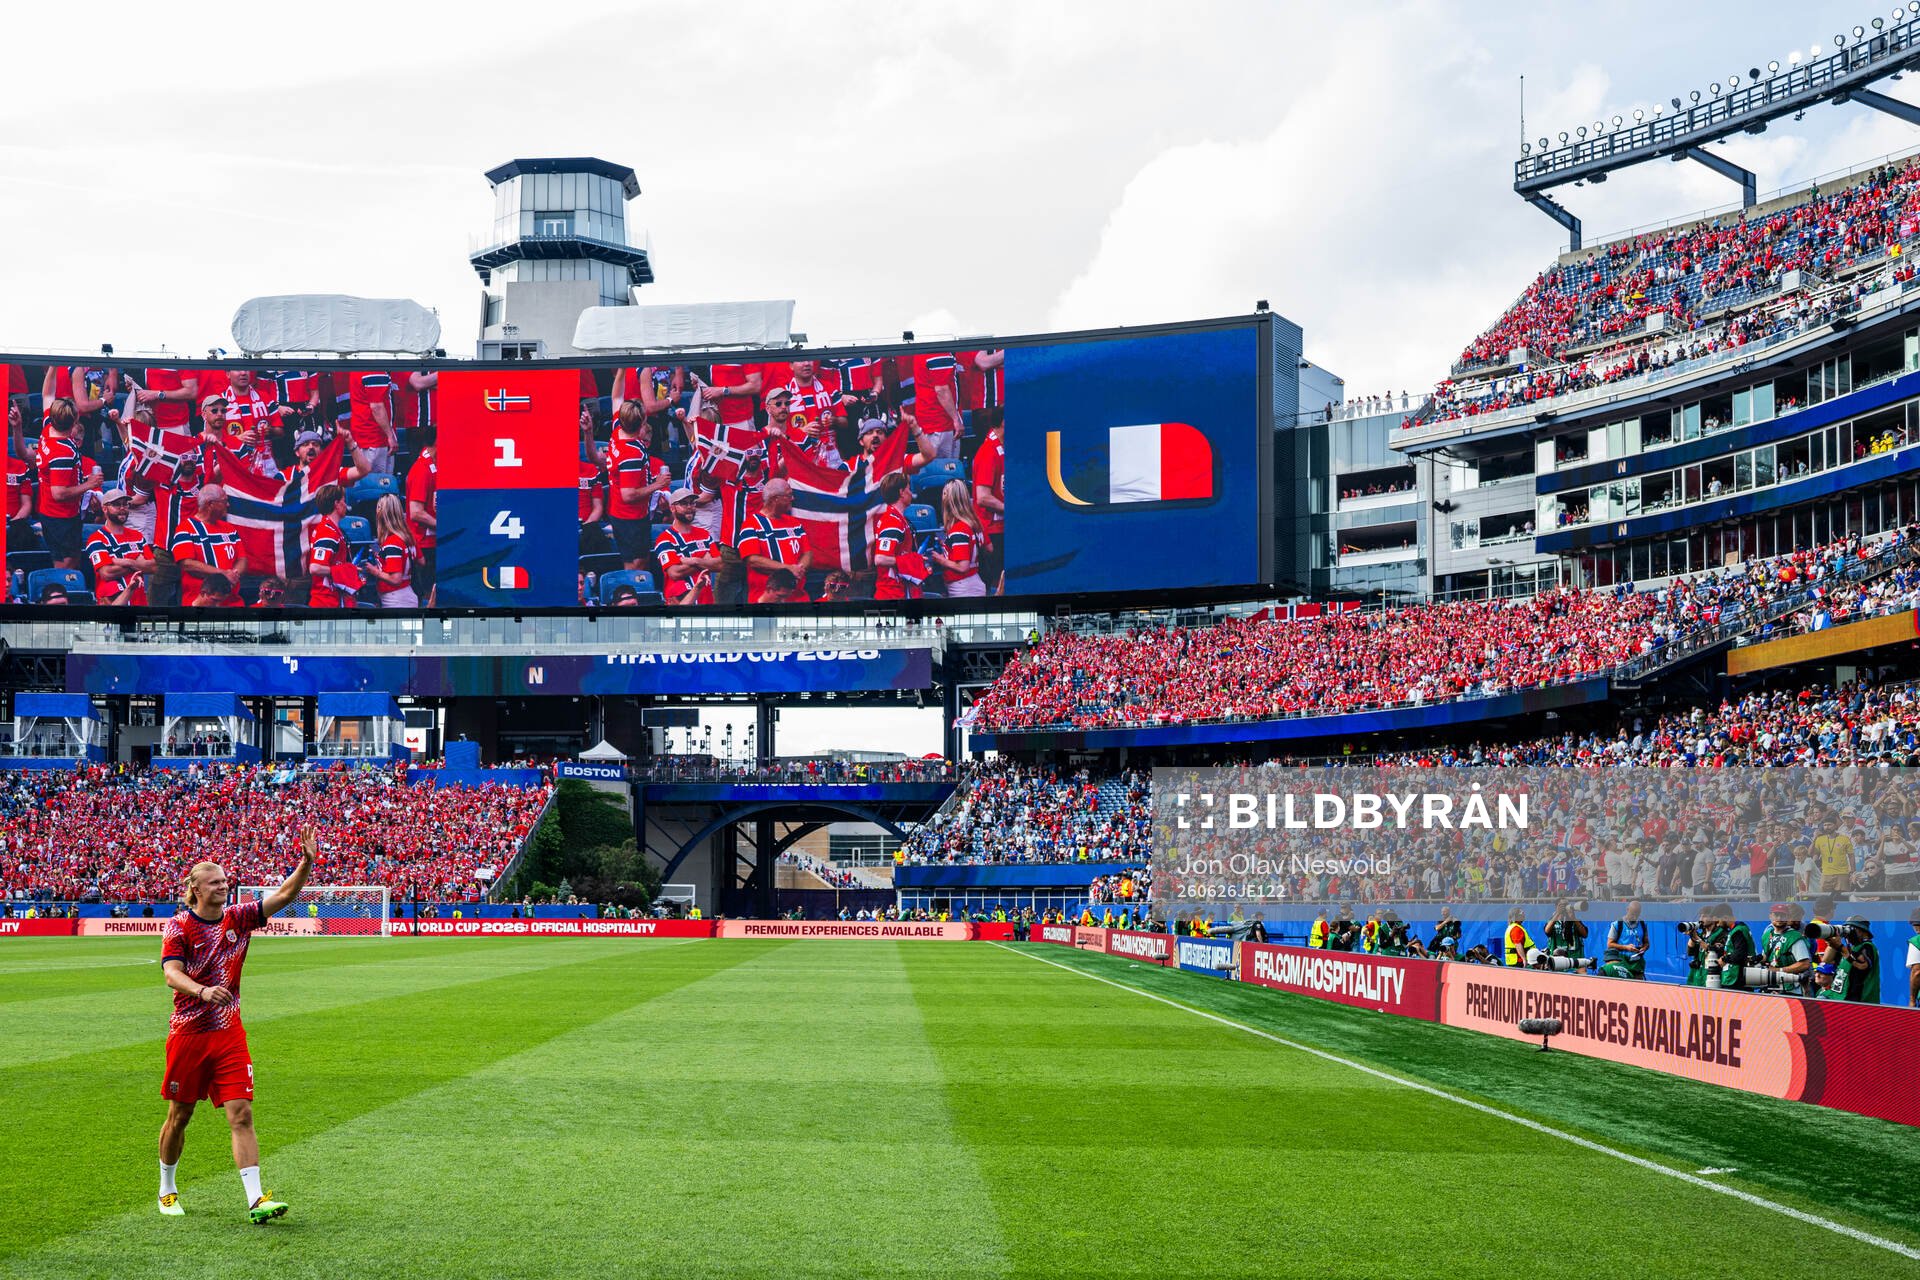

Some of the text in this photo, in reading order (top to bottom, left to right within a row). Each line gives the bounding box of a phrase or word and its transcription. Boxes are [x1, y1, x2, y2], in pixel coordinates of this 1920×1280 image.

[494, 438, 523, 467] 1
[490, 510, 525, 539] 4
[607, 652, 656, 665] FIFA
[661, 650, 746, 663] WORLD
[749, 650, 792, 663] CUP
[528, 667, 544, 684] N
[564, 766, 621, 778] BOSTON
[104, 922, 157, 932] PREMIUM
[458, 922, 480, 932] CUP
[531, 922, 580, 933] OFFICIAL
[582, 922, 656, 933] HOSPITALITY
[744, 925, 943, 937] PREMIUM EXPERIENCES AVAILABLE
[1254, 951, 1405, 1005] FIFA.COM/HOSPITALITY
[1466, 982, 1742, 1068] PREMIUM EXPERIENCES AVAILABLE
